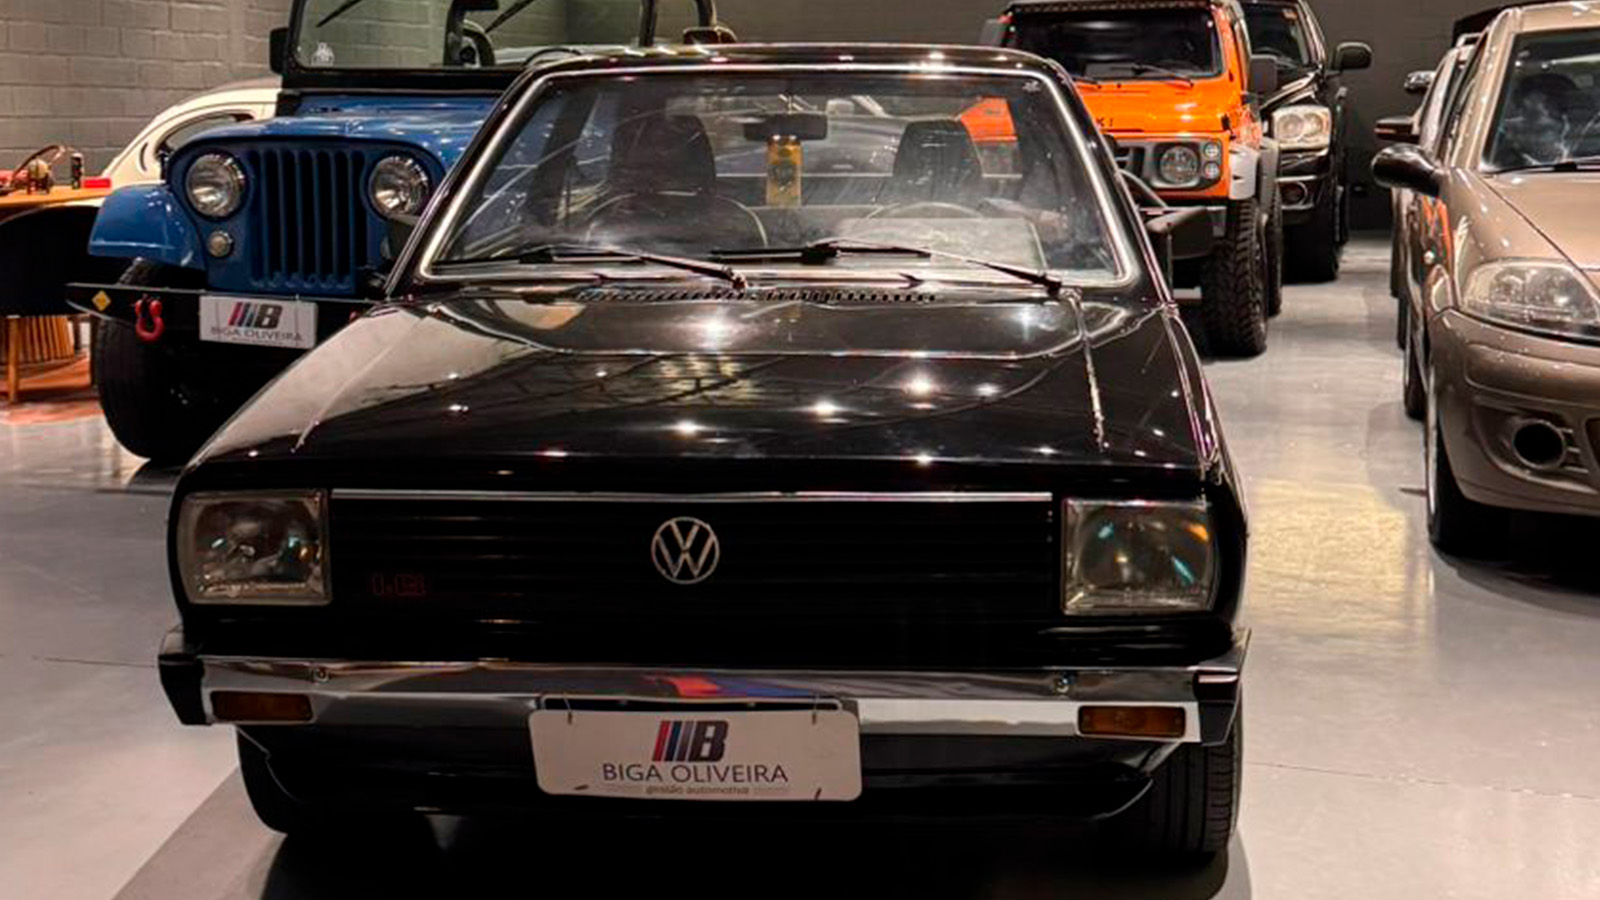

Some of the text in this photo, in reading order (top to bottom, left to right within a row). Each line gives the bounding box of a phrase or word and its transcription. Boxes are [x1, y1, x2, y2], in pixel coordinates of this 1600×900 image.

[244, 329, 303, 342] OLIVEIRA
[651, 516, 720, 585] VW
[602, 763, 789, 783] BIGA OLIVEIRA
